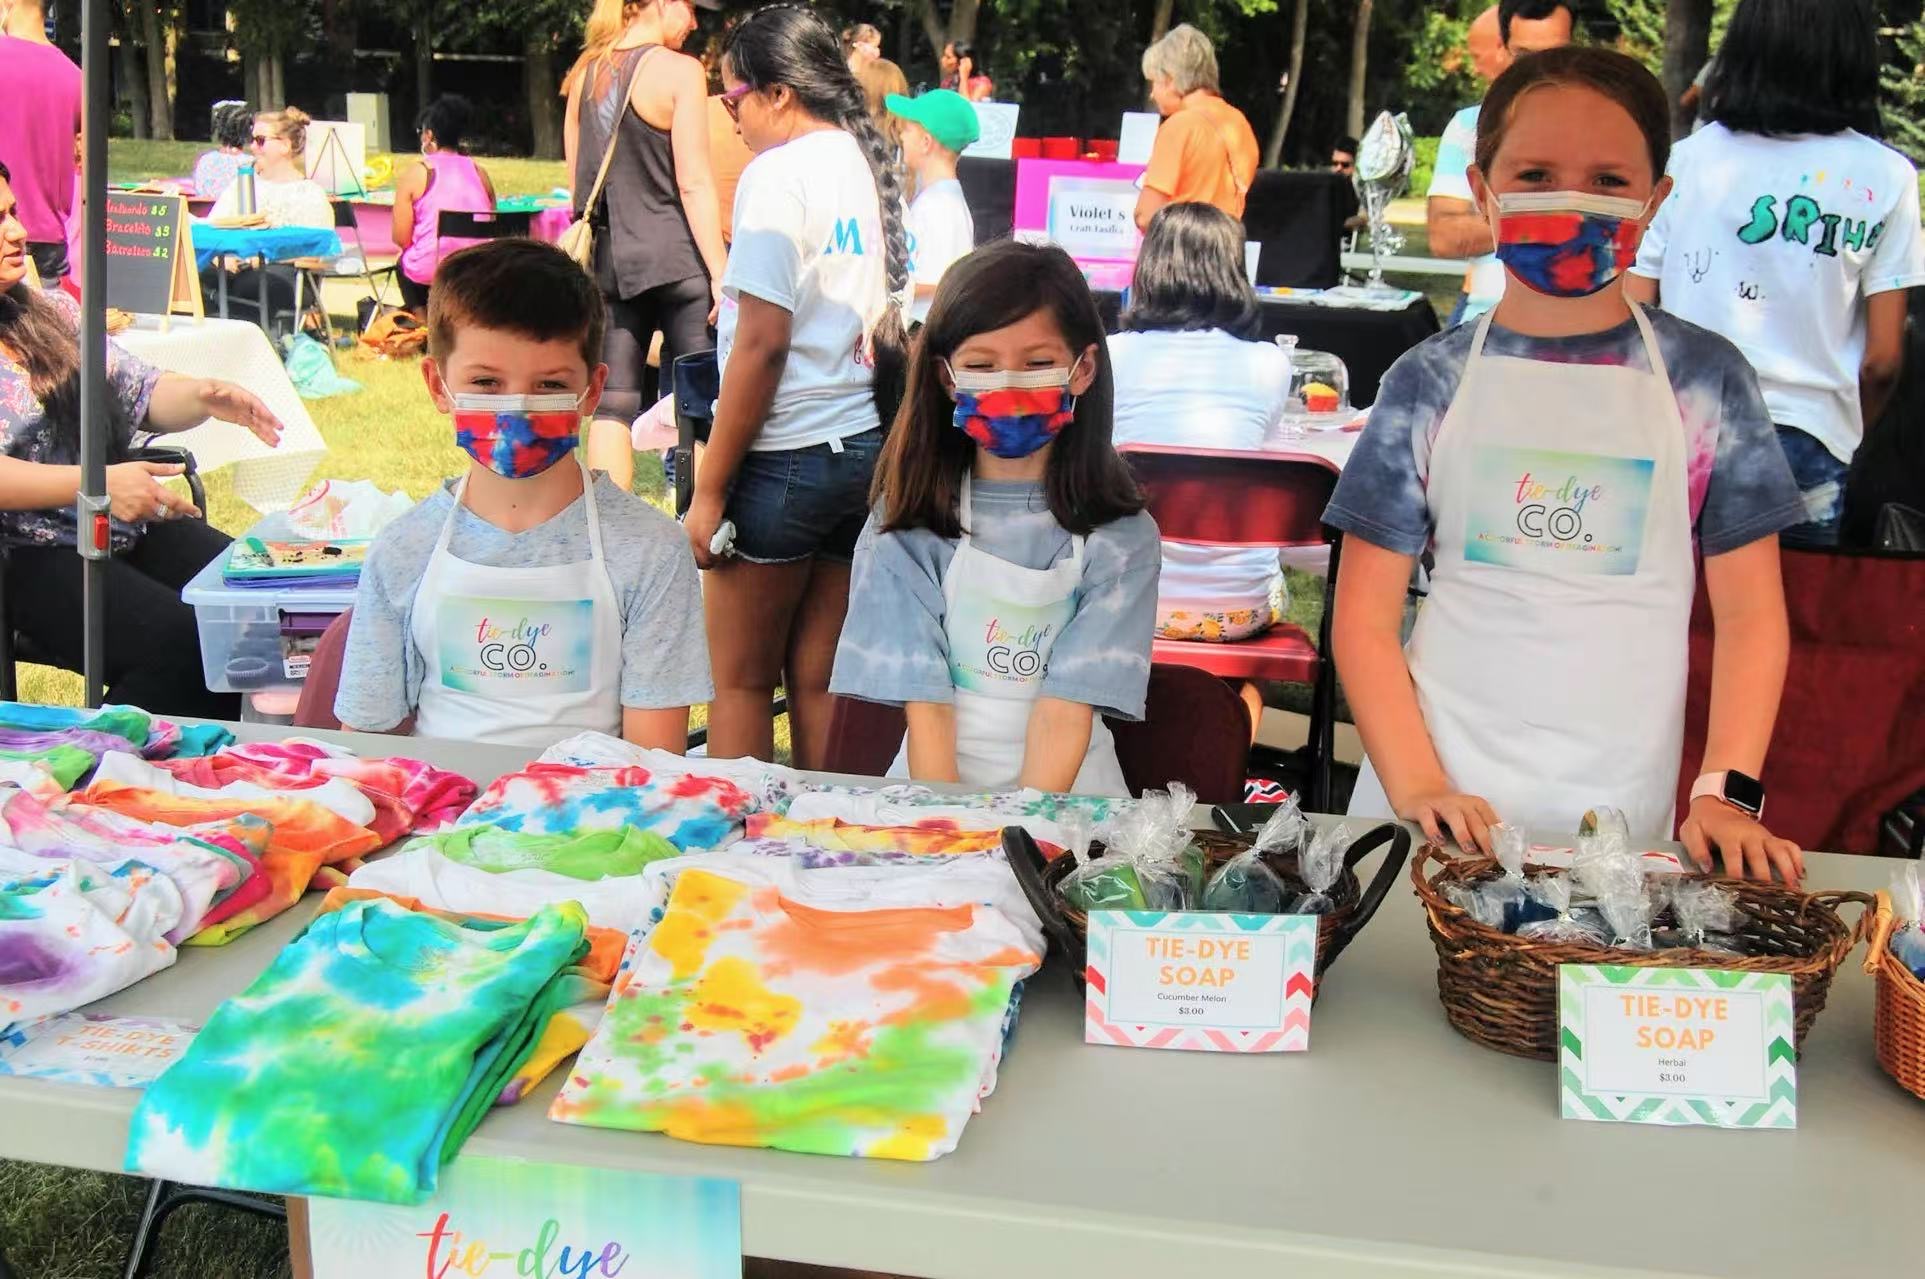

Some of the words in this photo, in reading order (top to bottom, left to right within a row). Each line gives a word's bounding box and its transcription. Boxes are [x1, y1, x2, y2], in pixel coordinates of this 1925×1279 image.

[1517, 504, 1593, 542] CO.
[480, 643, 547, 671] CO.
[987, 646, 1048, 677] CO.
[1146, 936, 1251, 962] TIE-DYE
[1158, 965, 1236, 988] SOAP
[1157, 992, 1199, 1002] Cucumber
[1201, 994, 1227, 1004] Melon
[1620, 994, 1728, 1020] TIE-DYE
[1178, 1006, 1204, 1016] $3.00
[1635, 1026, 1715, 1050] SOAP
[1658, 1058, 1687, 1068] Herbal
[1659, 1073, 1686, 1083] $3.00
[415, 1212, 630, 1279] tie-dye
